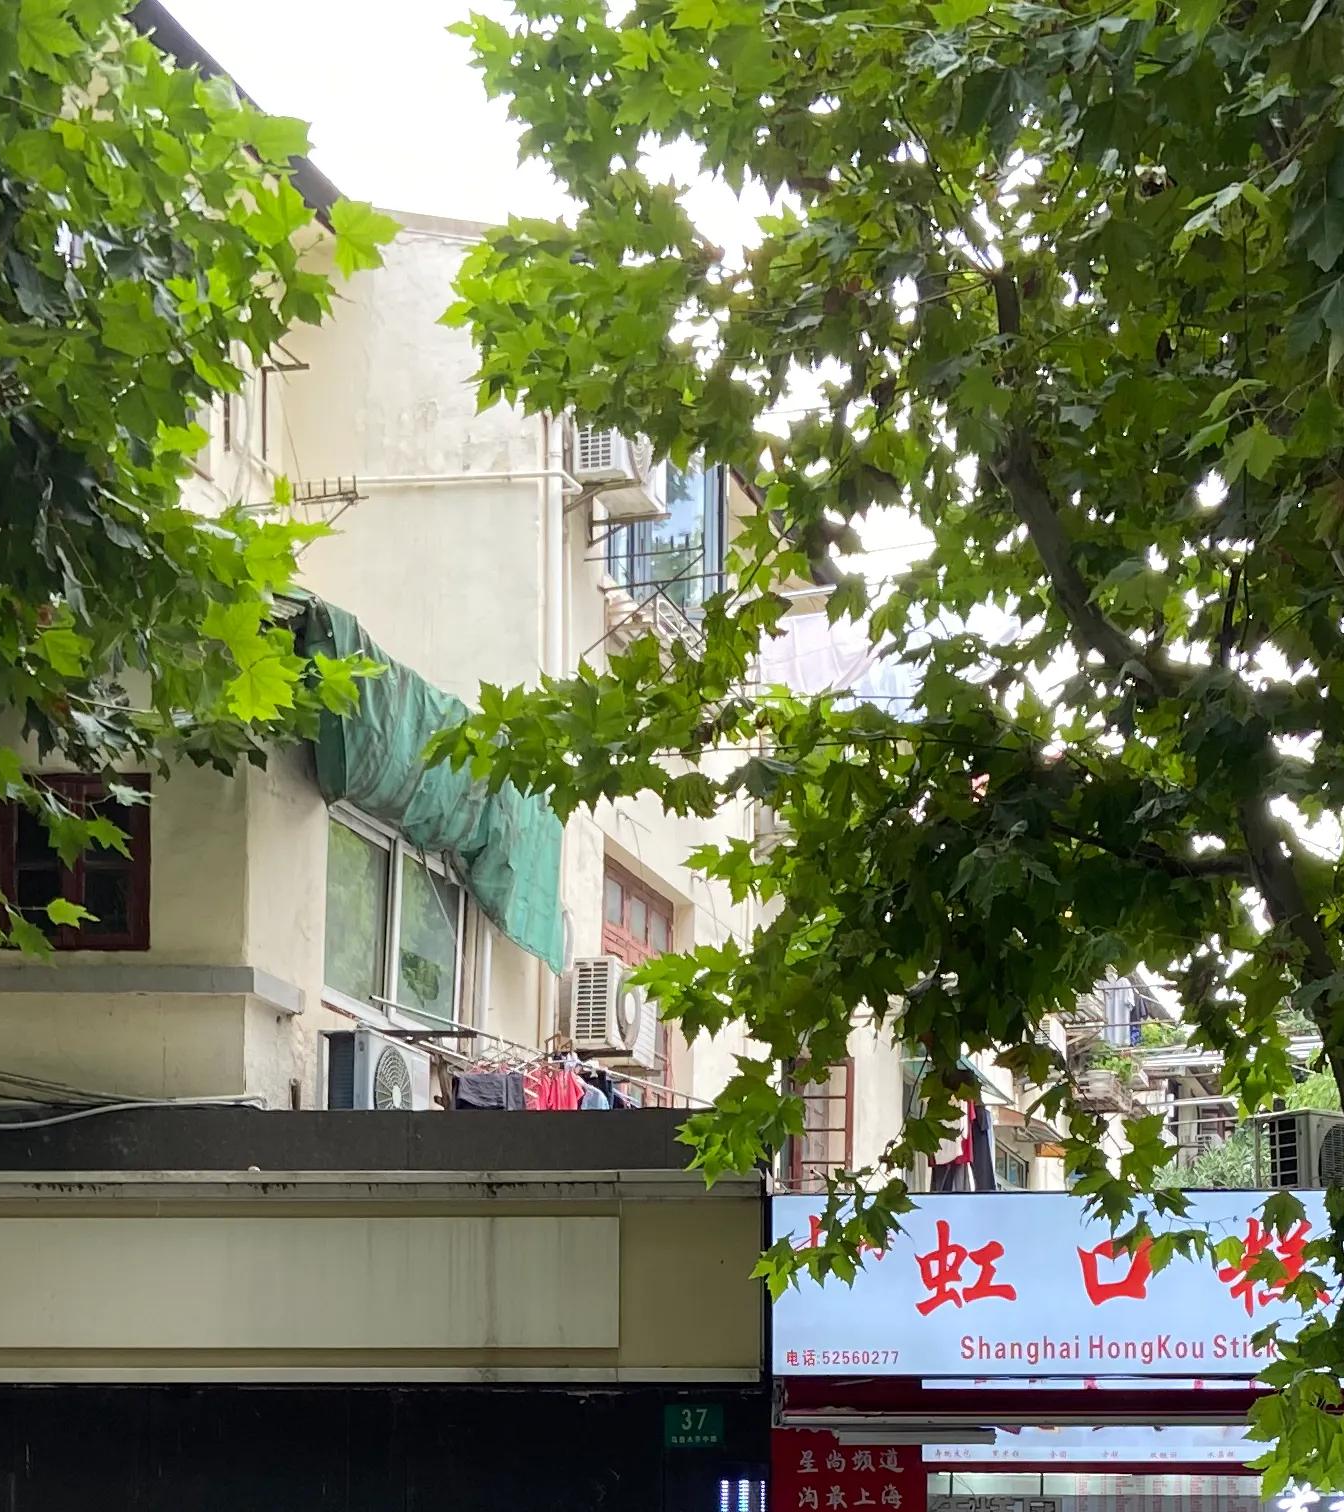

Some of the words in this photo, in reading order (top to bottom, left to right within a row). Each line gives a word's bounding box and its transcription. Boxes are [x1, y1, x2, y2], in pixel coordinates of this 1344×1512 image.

[960, 1334, 1080, 1364] Shanghai
[1089, 1334, 1204, 1365] HongKou
[1213, 1333, 1281, 1360] Stick
[681, 1408, 708, 1431] 37
